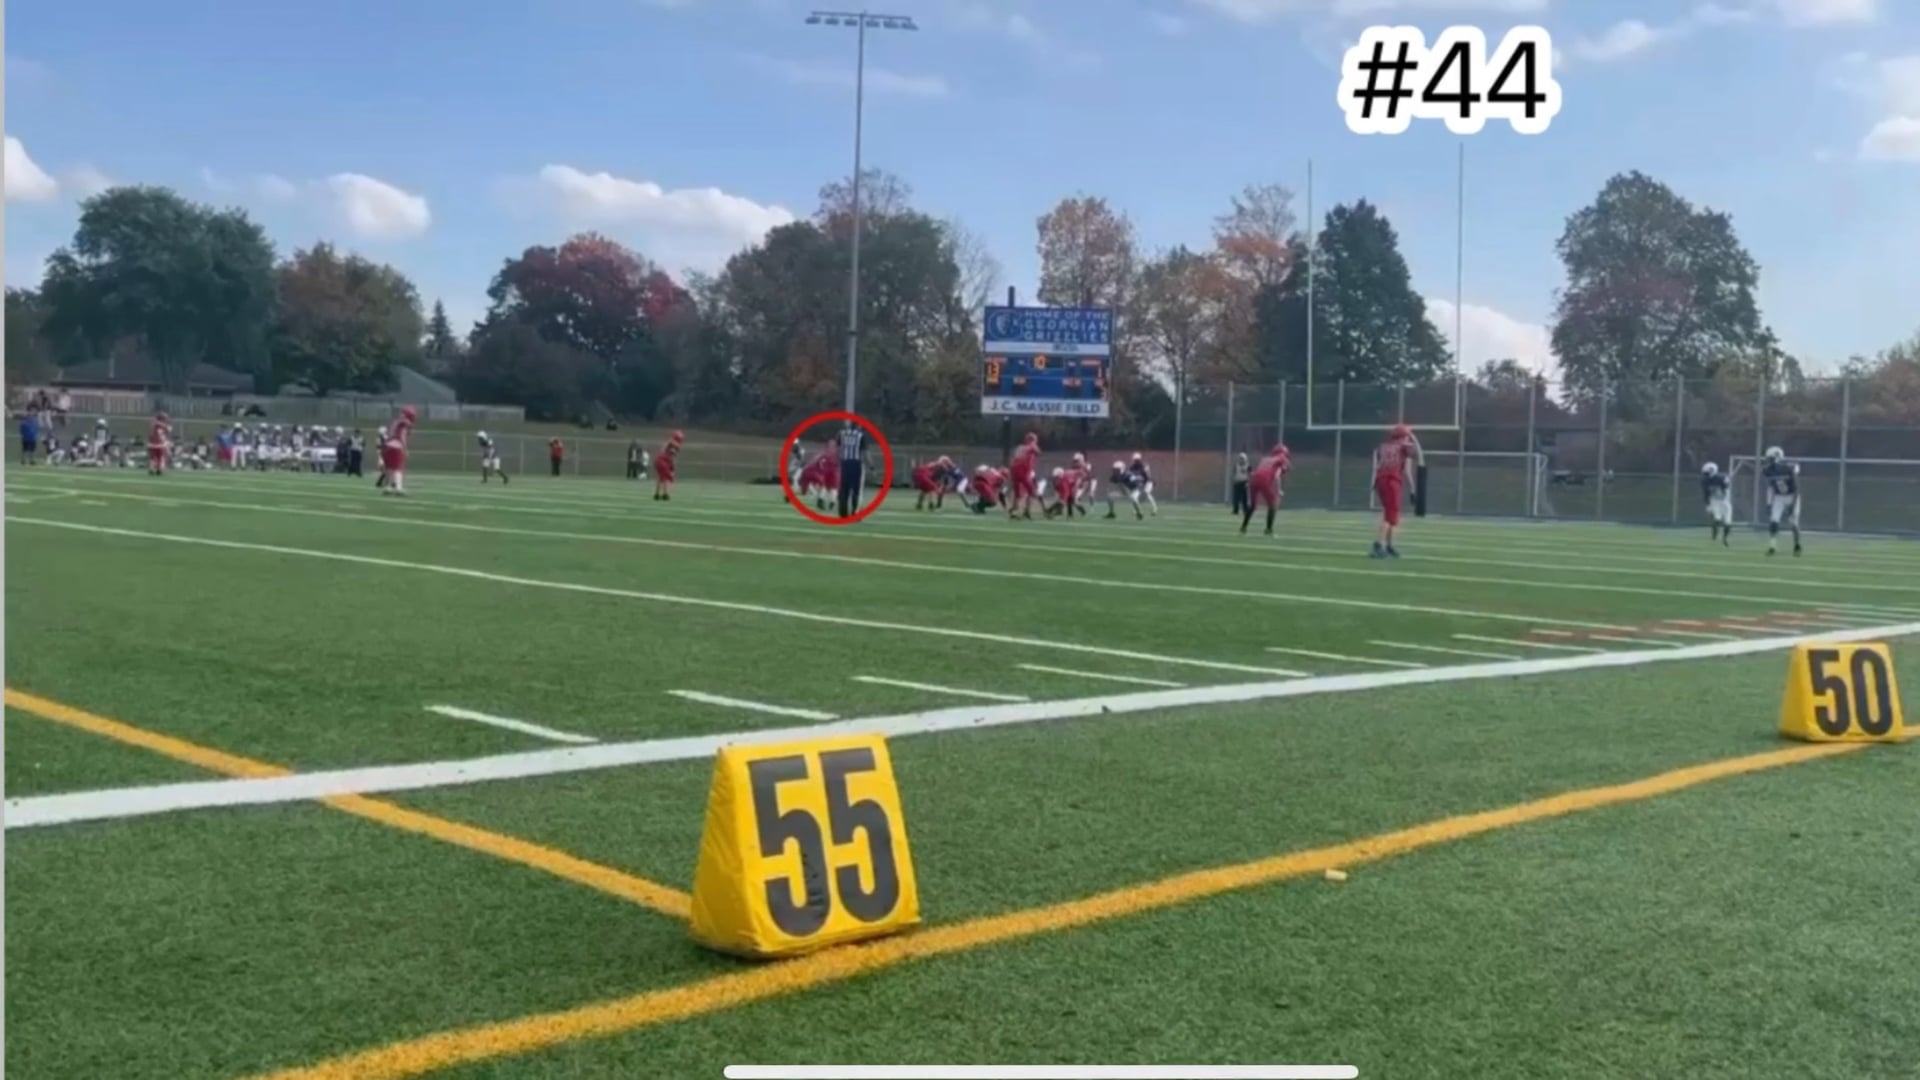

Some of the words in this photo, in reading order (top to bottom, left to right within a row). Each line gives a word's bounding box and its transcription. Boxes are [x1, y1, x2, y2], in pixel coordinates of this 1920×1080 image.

[1024, 310, 1060, 319] HOME
[1064, 311, 1081, 320] OF
[1085, 311, 1108, 320] THE
[1024, 319, 1109, 331] GEORGIAN
[1024, 330, 1109, 342] GRIZZLIES
[1016, 401, 1061, 412] MASSIE
[1065, 402, 1101, 413] FIELD
[1807, 648, 1893, 736] 50
[747, 747, 900, 937] 55
